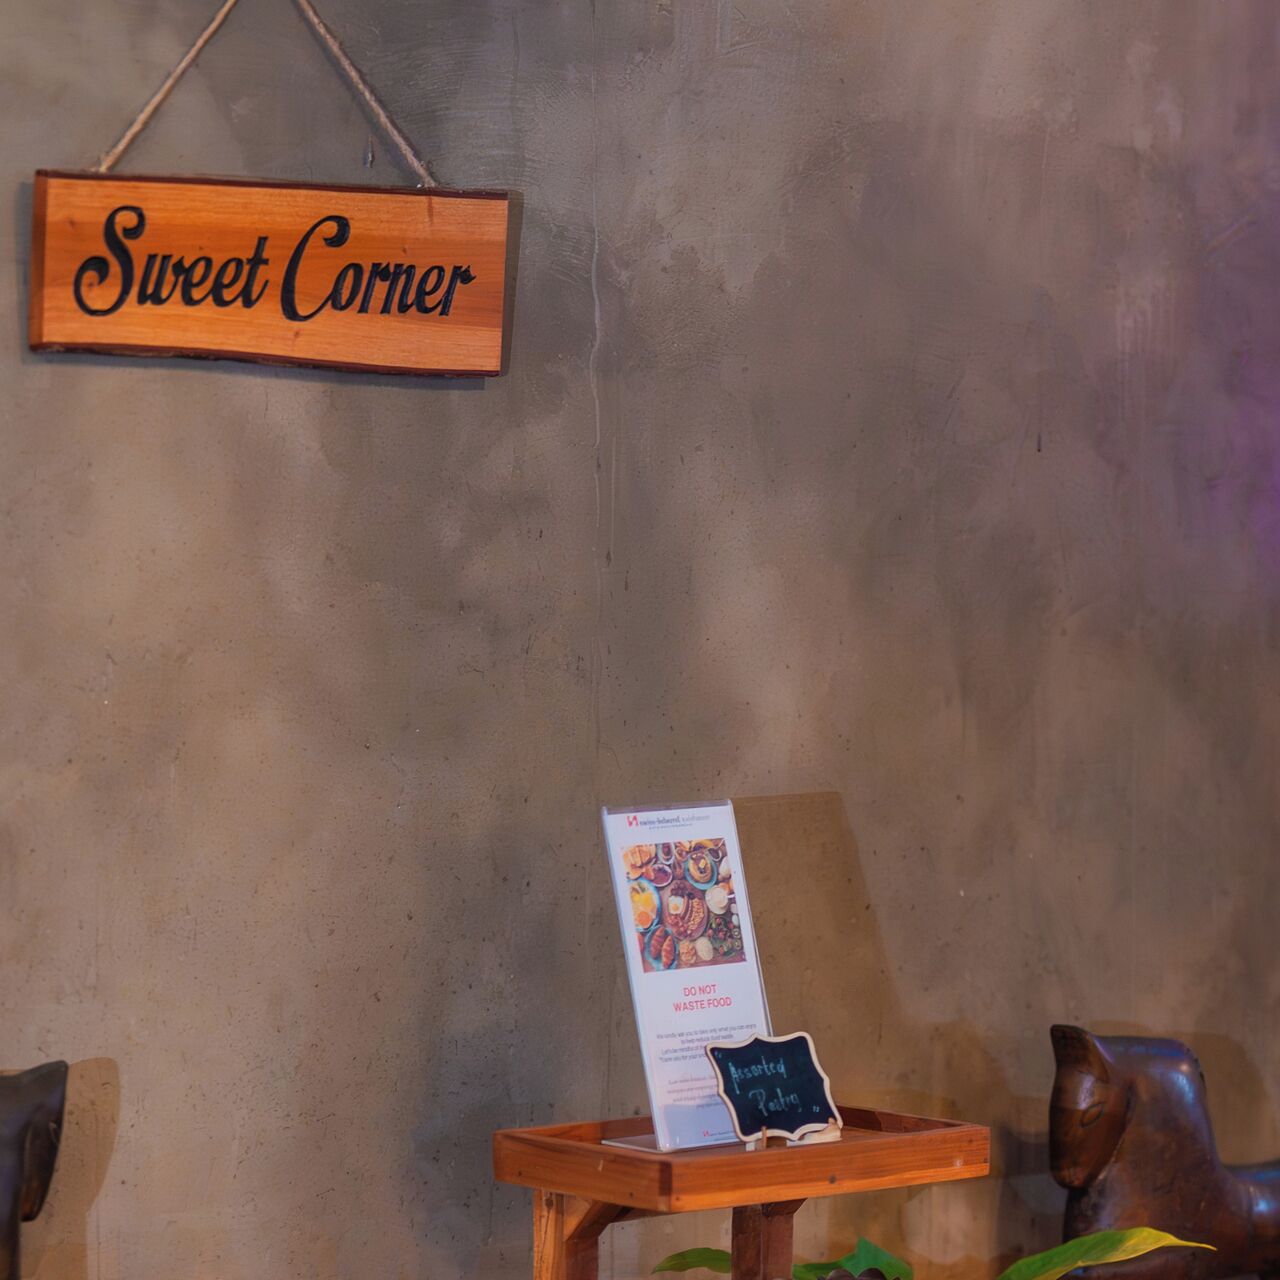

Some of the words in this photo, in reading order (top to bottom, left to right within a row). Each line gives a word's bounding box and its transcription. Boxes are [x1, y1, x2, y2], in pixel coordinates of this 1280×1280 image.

[74, 206, 269, 316] Sweet
[281, 215, 475, 322] Corner
[683, 987, 697, 997] DO
[698, 984, 717, 995] NOT
[673, 1000, 706, 1011] WASTE
[707, 997, 732, 1008] FOOD
